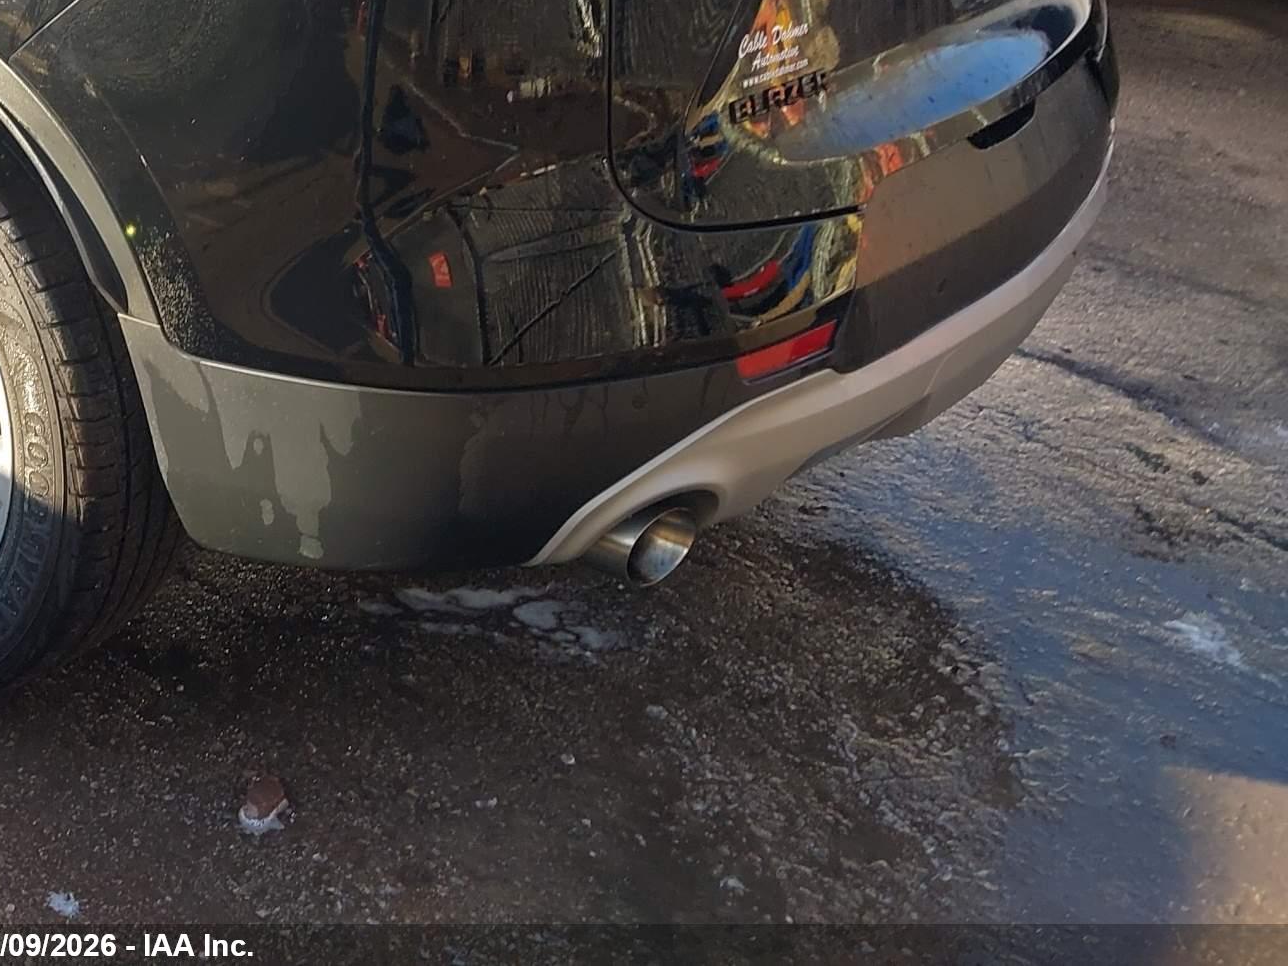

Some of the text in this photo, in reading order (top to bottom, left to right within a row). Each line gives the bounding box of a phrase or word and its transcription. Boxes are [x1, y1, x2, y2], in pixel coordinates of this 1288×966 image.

[738, 21, 809, 59] Cable Dahmer
[728, 68, 829, 125] BLAZER
